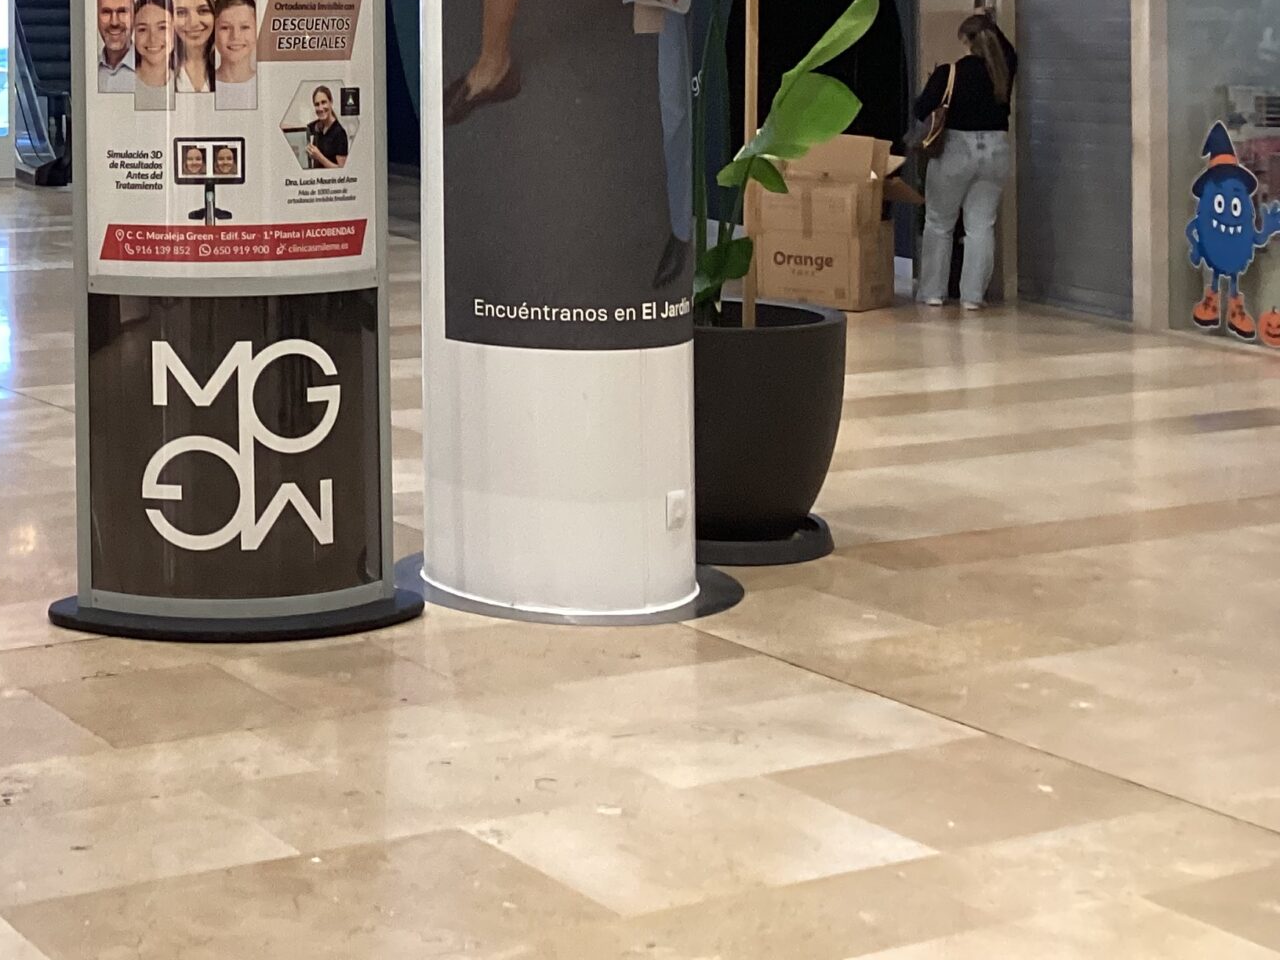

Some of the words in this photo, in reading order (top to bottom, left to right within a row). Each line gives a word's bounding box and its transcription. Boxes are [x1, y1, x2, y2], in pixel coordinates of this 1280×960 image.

[274, 1, 316, 11] Ortodoncia
[271, 18, 351, 32] DESCUENTOS
[277, 36, 347, 50] ESPECIALES
[107, 150, 149, 159] Simulación
[150, 150, 163, 159] 3D
[109, 161, 119, 169] de
[119, 161, 163, 169] Resultados
[126, 171, 149, 180] Antes
[150, 171, 163, 179] del
[115, 181, 163, 190] Tratamiento
[146, 231, 184, 242] Moraleja
[186, 232, 213, 240] Green
[241, 232, 256, 240] Sur
[274, 230, 300, 239] Planta
[306, 226, 355, 238] ALCOBENDAS
[135, 245, 152, 254] 916
[155, 245, 171, 254] 139
[173, 246, 191, 255] 852
[213, 246, 231, 255] 650
[233, 246, 251, 255] 919
[252, 245, 270, 254] 900
[773, 251, 834, 271] Orange
[474, 298, 608, 322] Encuéntranos
[615, 307, 636, 321] en
[642, 301, 657, 320] El
